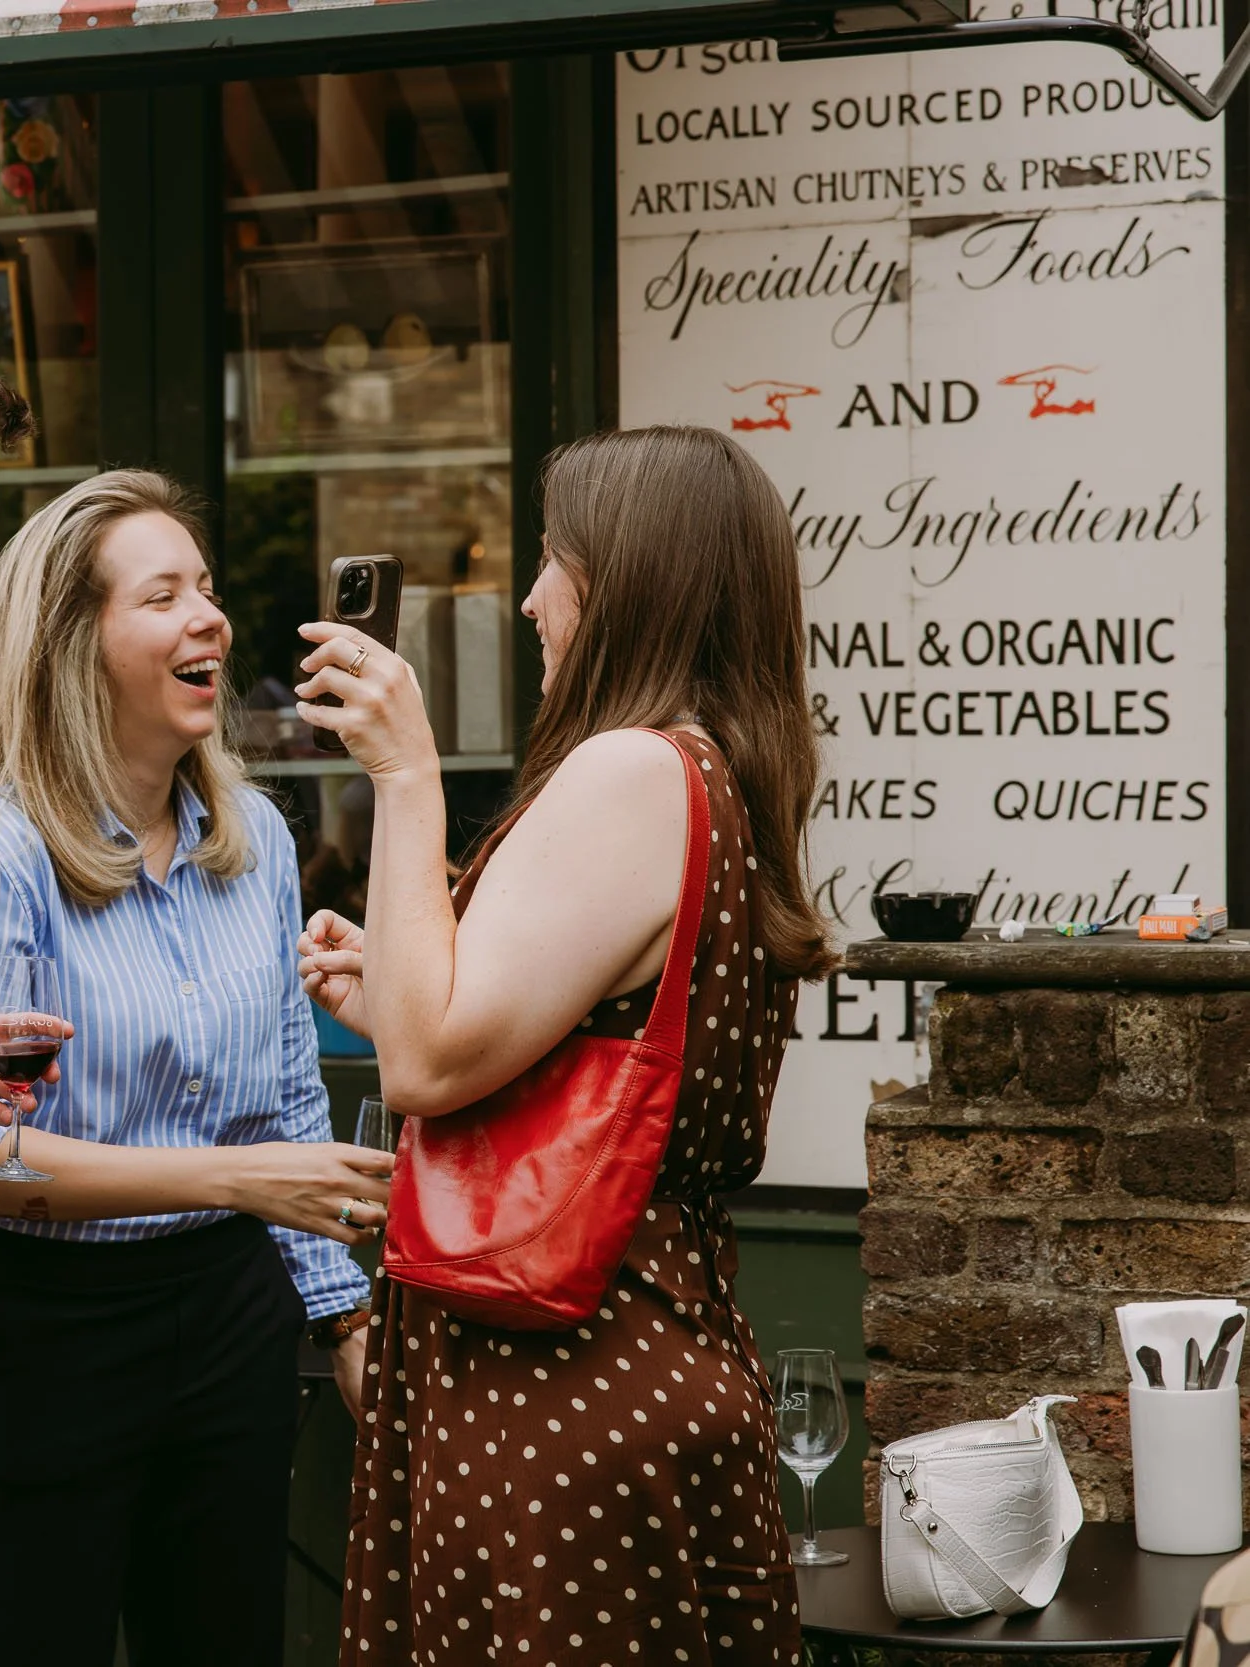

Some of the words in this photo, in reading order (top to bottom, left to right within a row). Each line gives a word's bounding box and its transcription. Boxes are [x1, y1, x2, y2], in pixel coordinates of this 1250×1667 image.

[637, 103, 789, 144] LOCALLY
[812, 88, 1002, 131] SOURCED
[631, 177, 776, 215] ARTISAN
[794, 164, 965, 203] CHUTNEYS
[983, 163, 1007, 191] &
[645, 230, 910, 349] Speciality
[957, 216, 1191, 289] Foods
[837, 380, 979, 429] AND
[858, 475, 1210, 587] Ingredients
[918, 621, 951, 668] &
[961, 617, 1175, 666] ORGANIC
[810, 692, 839, 736] &
[859, 690, 1170, 736] VEGETABLES
[994, 780, 1209, 821] QUICHES
